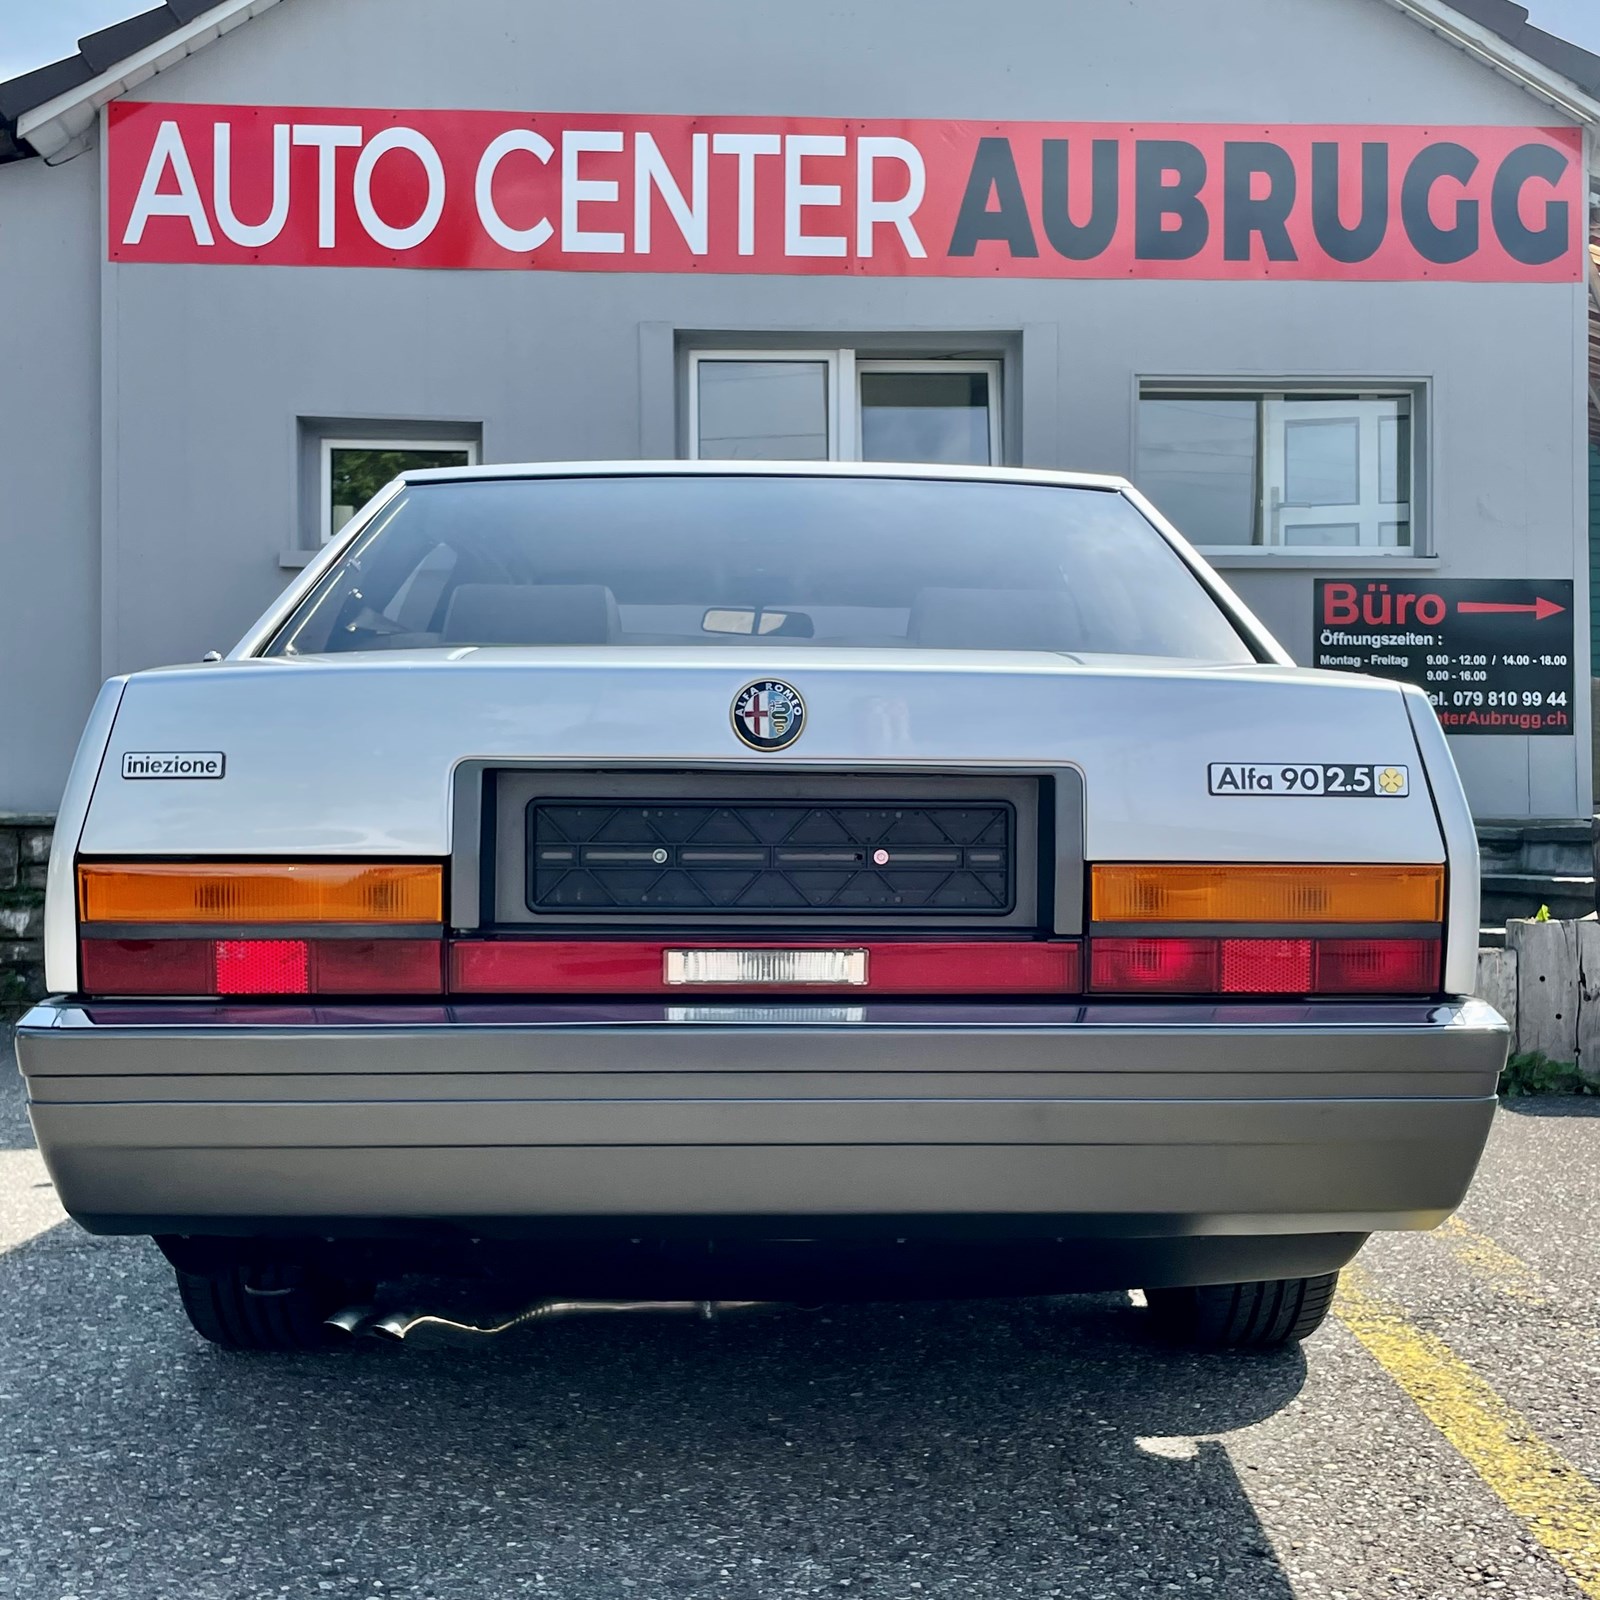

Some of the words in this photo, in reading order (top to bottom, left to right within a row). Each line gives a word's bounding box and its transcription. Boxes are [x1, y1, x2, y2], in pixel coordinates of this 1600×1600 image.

[122, 121, 446, 250] AUTO
[475, 128, 928, 259] CENTER
[947, 136, 1570, 266] AUBRUGG
[1323, 583, 1447, 626] Büro
[1320, 629, 1433, 649] Öffnungszeiten
[1320, 655, 1361, 668] Montag
[1370, 655, 1409, 668] Freitag
[1426, 655, 1449, 666] 9.00
[1459, 655, 1487, 666] 12.00
[1502, 655, 1529, 666] 14.00
[1539, 655, 1567, 666] 18.00
[1426, 671, 1449, 681] 9.00
[1459, 671, 1487, 681] 16.00
[735, 686, 760, 717] ALFA
[765, 682, 802, 716] ROMEO
[1453, 691, 1483, 706] 079
[1487, 691, 1517, 706] 810
[1522, 691, 1542, 706] 99
[1547, 691, 1567, 706] 44
[127, 755, 218, 773] iniezione
[1216, 767, 1273, 790] Alfa
[1280, 767, 1319, 791] 90
[1326, 766, 1371, 792] 2.5
